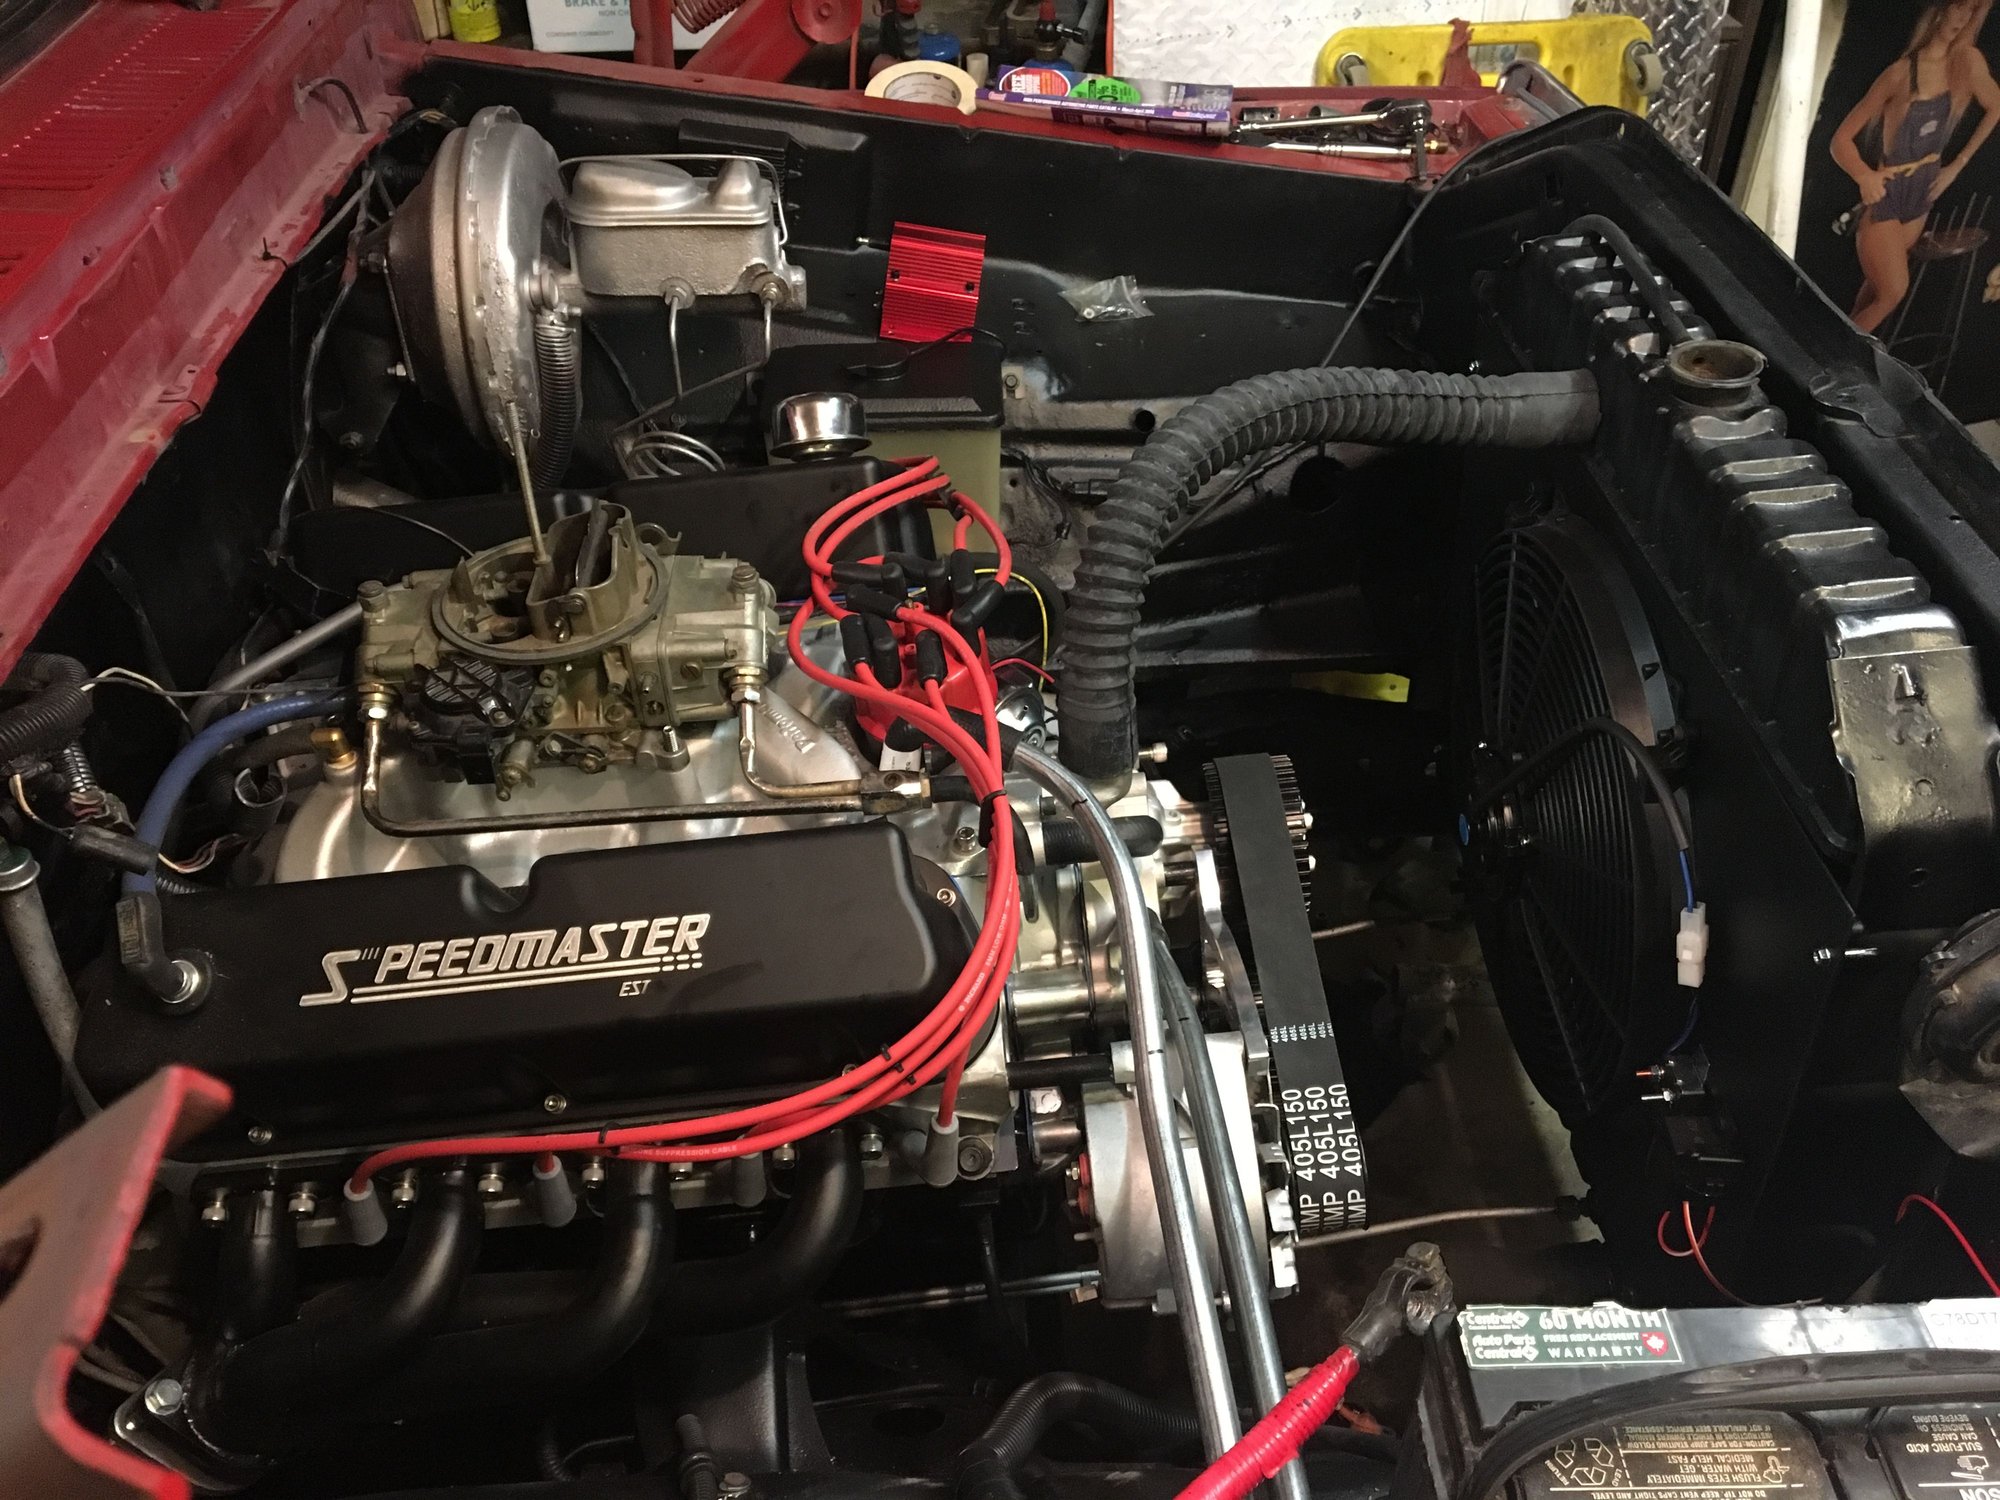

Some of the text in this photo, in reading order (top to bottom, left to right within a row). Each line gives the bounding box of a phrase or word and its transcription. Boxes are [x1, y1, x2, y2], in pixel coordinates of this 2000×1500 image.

[298, 913, 711, 1007] SPEEDMASTER
[618, 980, 651, 997] EST
[1270, 1026, 1279, 1043] 405L
[1279, 1025, 1288, 1043] 405L
[1289, 1025, 1297, 1041] 405L
[1299, 1023, 1307, 1040] 405L
[1308, 1022, 1317, 1039] 405L
[1318, 1021, 1326, 1038] 405L
[1538, 1310, 1662, 1330] 60 MONTH
[1472, 1334, 1536, 1347] Auto Parts
[1543, 1332, 1640, 1343] FREE REPLACEMENT
[1474, 1347, 1523, 1360] Central
[1547, 1346, 1643, 1359] WARRANTY
[1912, 1414, 1970, 1423] SEVERE BURNS
[1932, 1432, 1978, 1441] CAN CAUSE
[1627, 1441, 1655, 1449] FOLLOW
[1656, 1441, 1689, 1449] STARTING
[1711, 1440, 1727, 1448] SAFE
[1728, 1440, 1742, 1448] FOR
[1906, 1442, 1983, 1453] SULFURIC ACID
[1667, 1454, 1754, 1464] MEDICAL HELP FAST
[1680, 1464, 1696, 1474] GET
[1733, 1464, 1758, 1473] WITH
[1611, 1468, 1623, 1487] LEAD
[1647, 1474, 1762, 1484] FLUSH EYES IMMEDIATELY
[1591, 1492, 1614, 1500] LEVEL
[1657, 1491, 1678, 1499] CAPS
[1680, 1490, 1699, 1499] VENT
[1701, 1490, 1720, 1498] KEEP
[1738, 1490, 1753, 1498] NOT
[1754, 1490, 1767, 1498] DO
